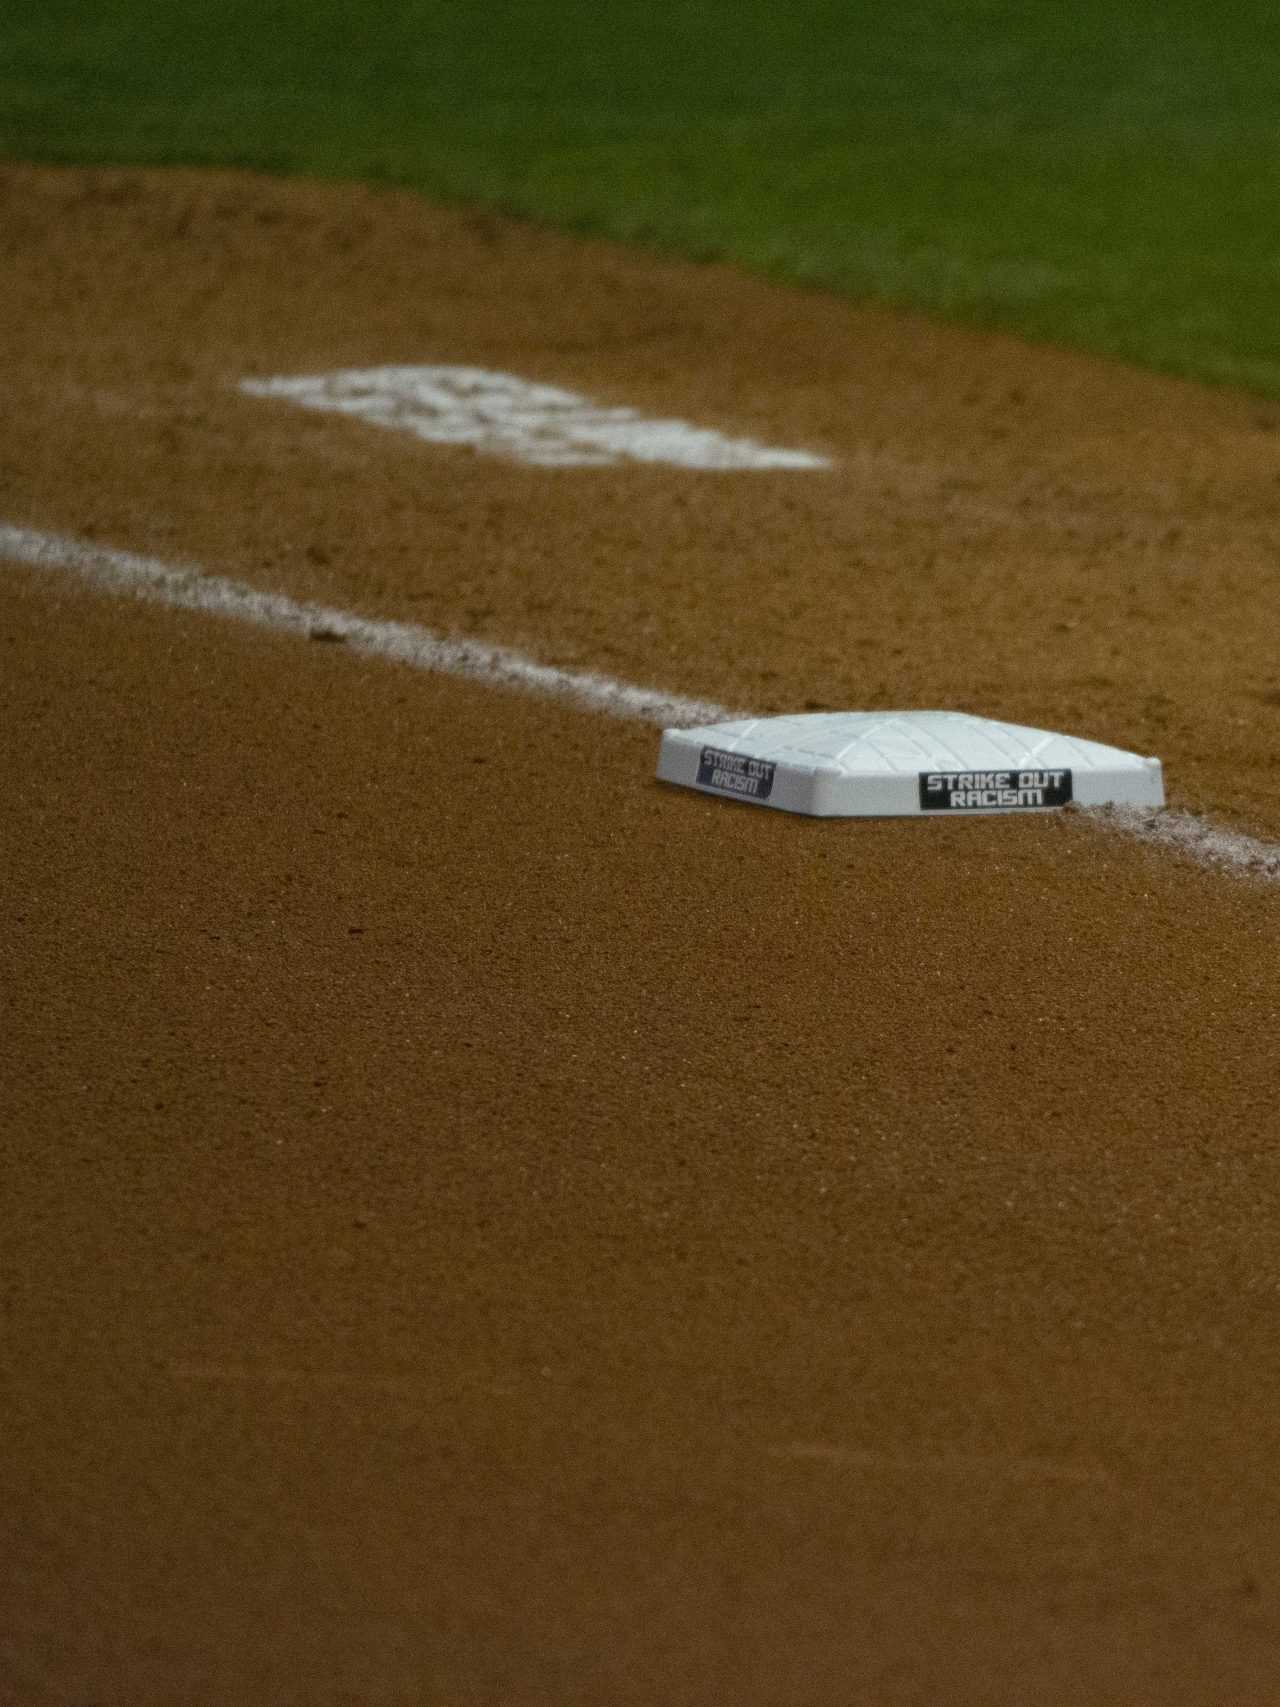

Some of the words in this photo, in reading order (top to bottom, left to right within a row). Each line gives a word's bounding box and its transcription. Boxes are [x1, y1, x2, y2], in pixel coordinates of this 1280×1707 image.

[703, 749, 745, 774] STRIKE
[748, 760, 773, 780] OUT
[711, 768, 758, 795] RACISM
[927, 773, 1010, 791] STRIKE
[1018, 771, 1065, 789] OUT
[950, 788, 1043, 807] RACISM
